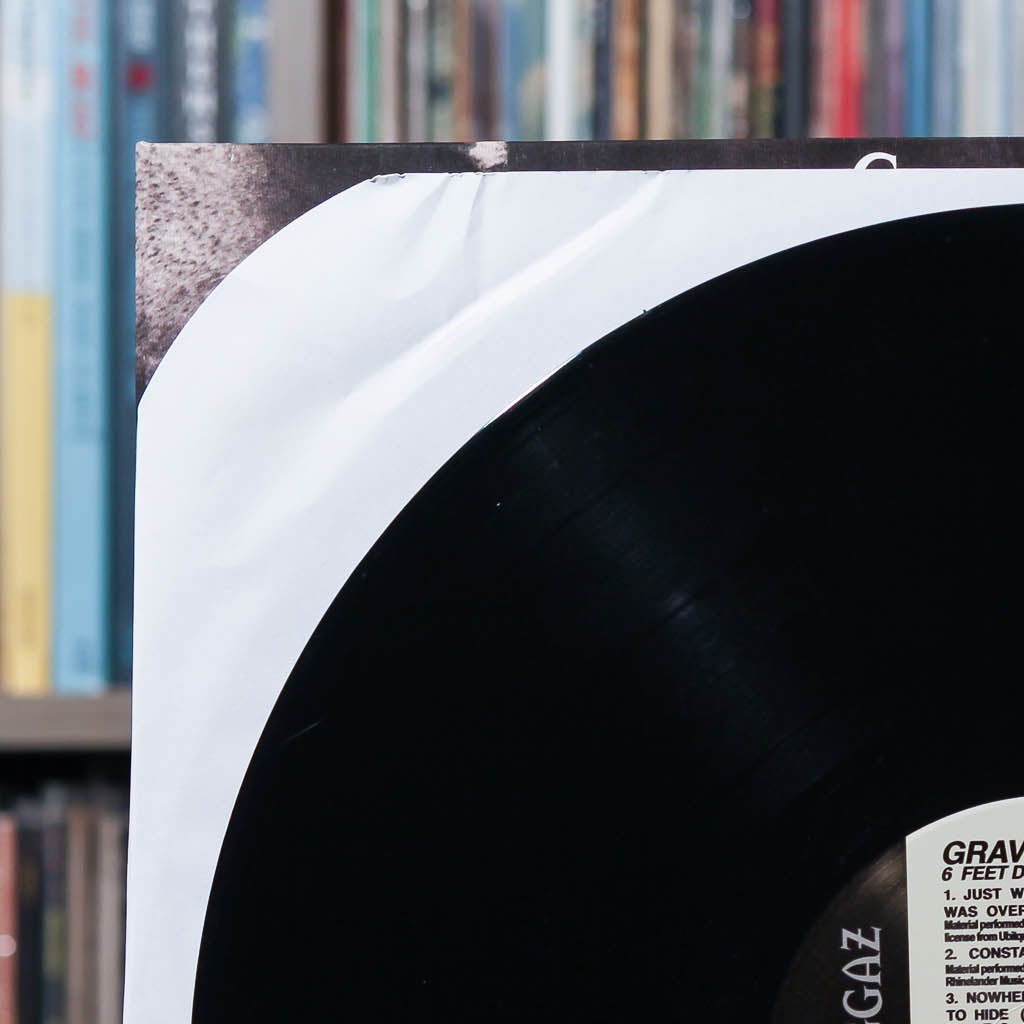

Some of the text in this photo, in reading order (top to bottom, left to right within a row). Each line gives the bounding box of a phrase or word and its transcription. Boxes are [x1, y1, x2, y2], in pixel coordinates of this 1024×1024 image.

[941, 867, 952, 881] 6
[961, 865, 1009, 881] FEET
[943, 889, 956, 901] 1.
[963, 888, 1002, 901] JUST
[943, 906, 977, 918] WAS
[944, 920, 978, 930] Material
[980, 918, 1024, 931] performed
[944, 933, 975, 942] license
[977, 932, 997, 941] from
[944, 949, 957, 960] 2.
[945, 965, 980, 974] Material
[945, 976, 999, 987] Rhinelander
[946, 992, 958, 1004] 3.
[946, 1009, 967, 1021] TO
[974, 1008, 1009, 1020] HIDE
